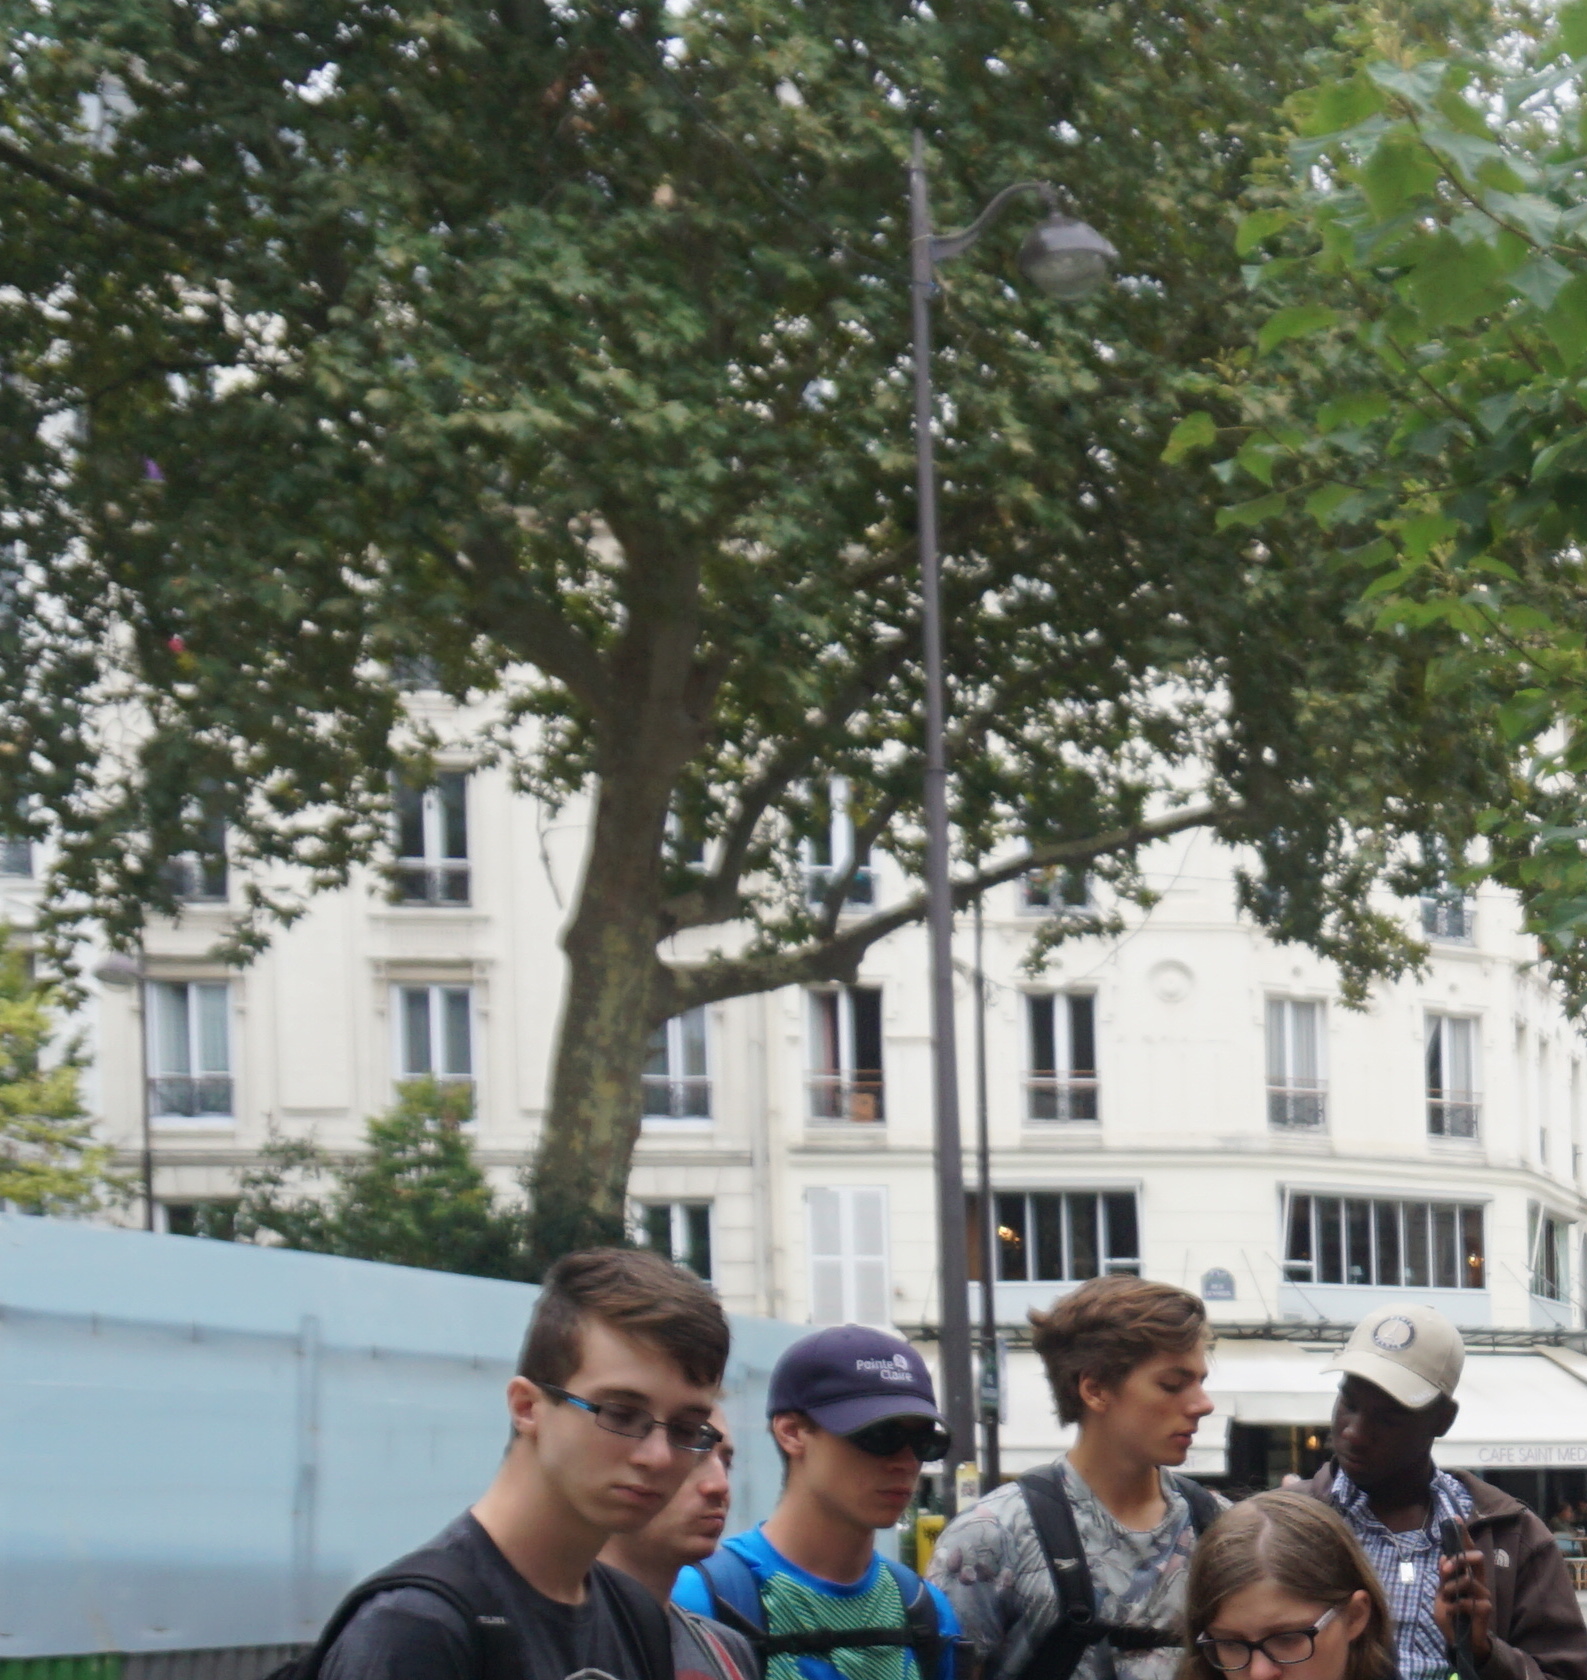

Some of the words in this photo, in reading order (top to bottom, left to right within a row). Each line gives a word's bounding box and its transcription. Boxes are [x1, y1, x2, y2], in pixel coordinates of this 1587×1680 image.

[856, 1358, 894, 1371] Pointe
[879, 1368, 914, 1383] Claire
[1518, 1447, 1553, 1462] SAINT
